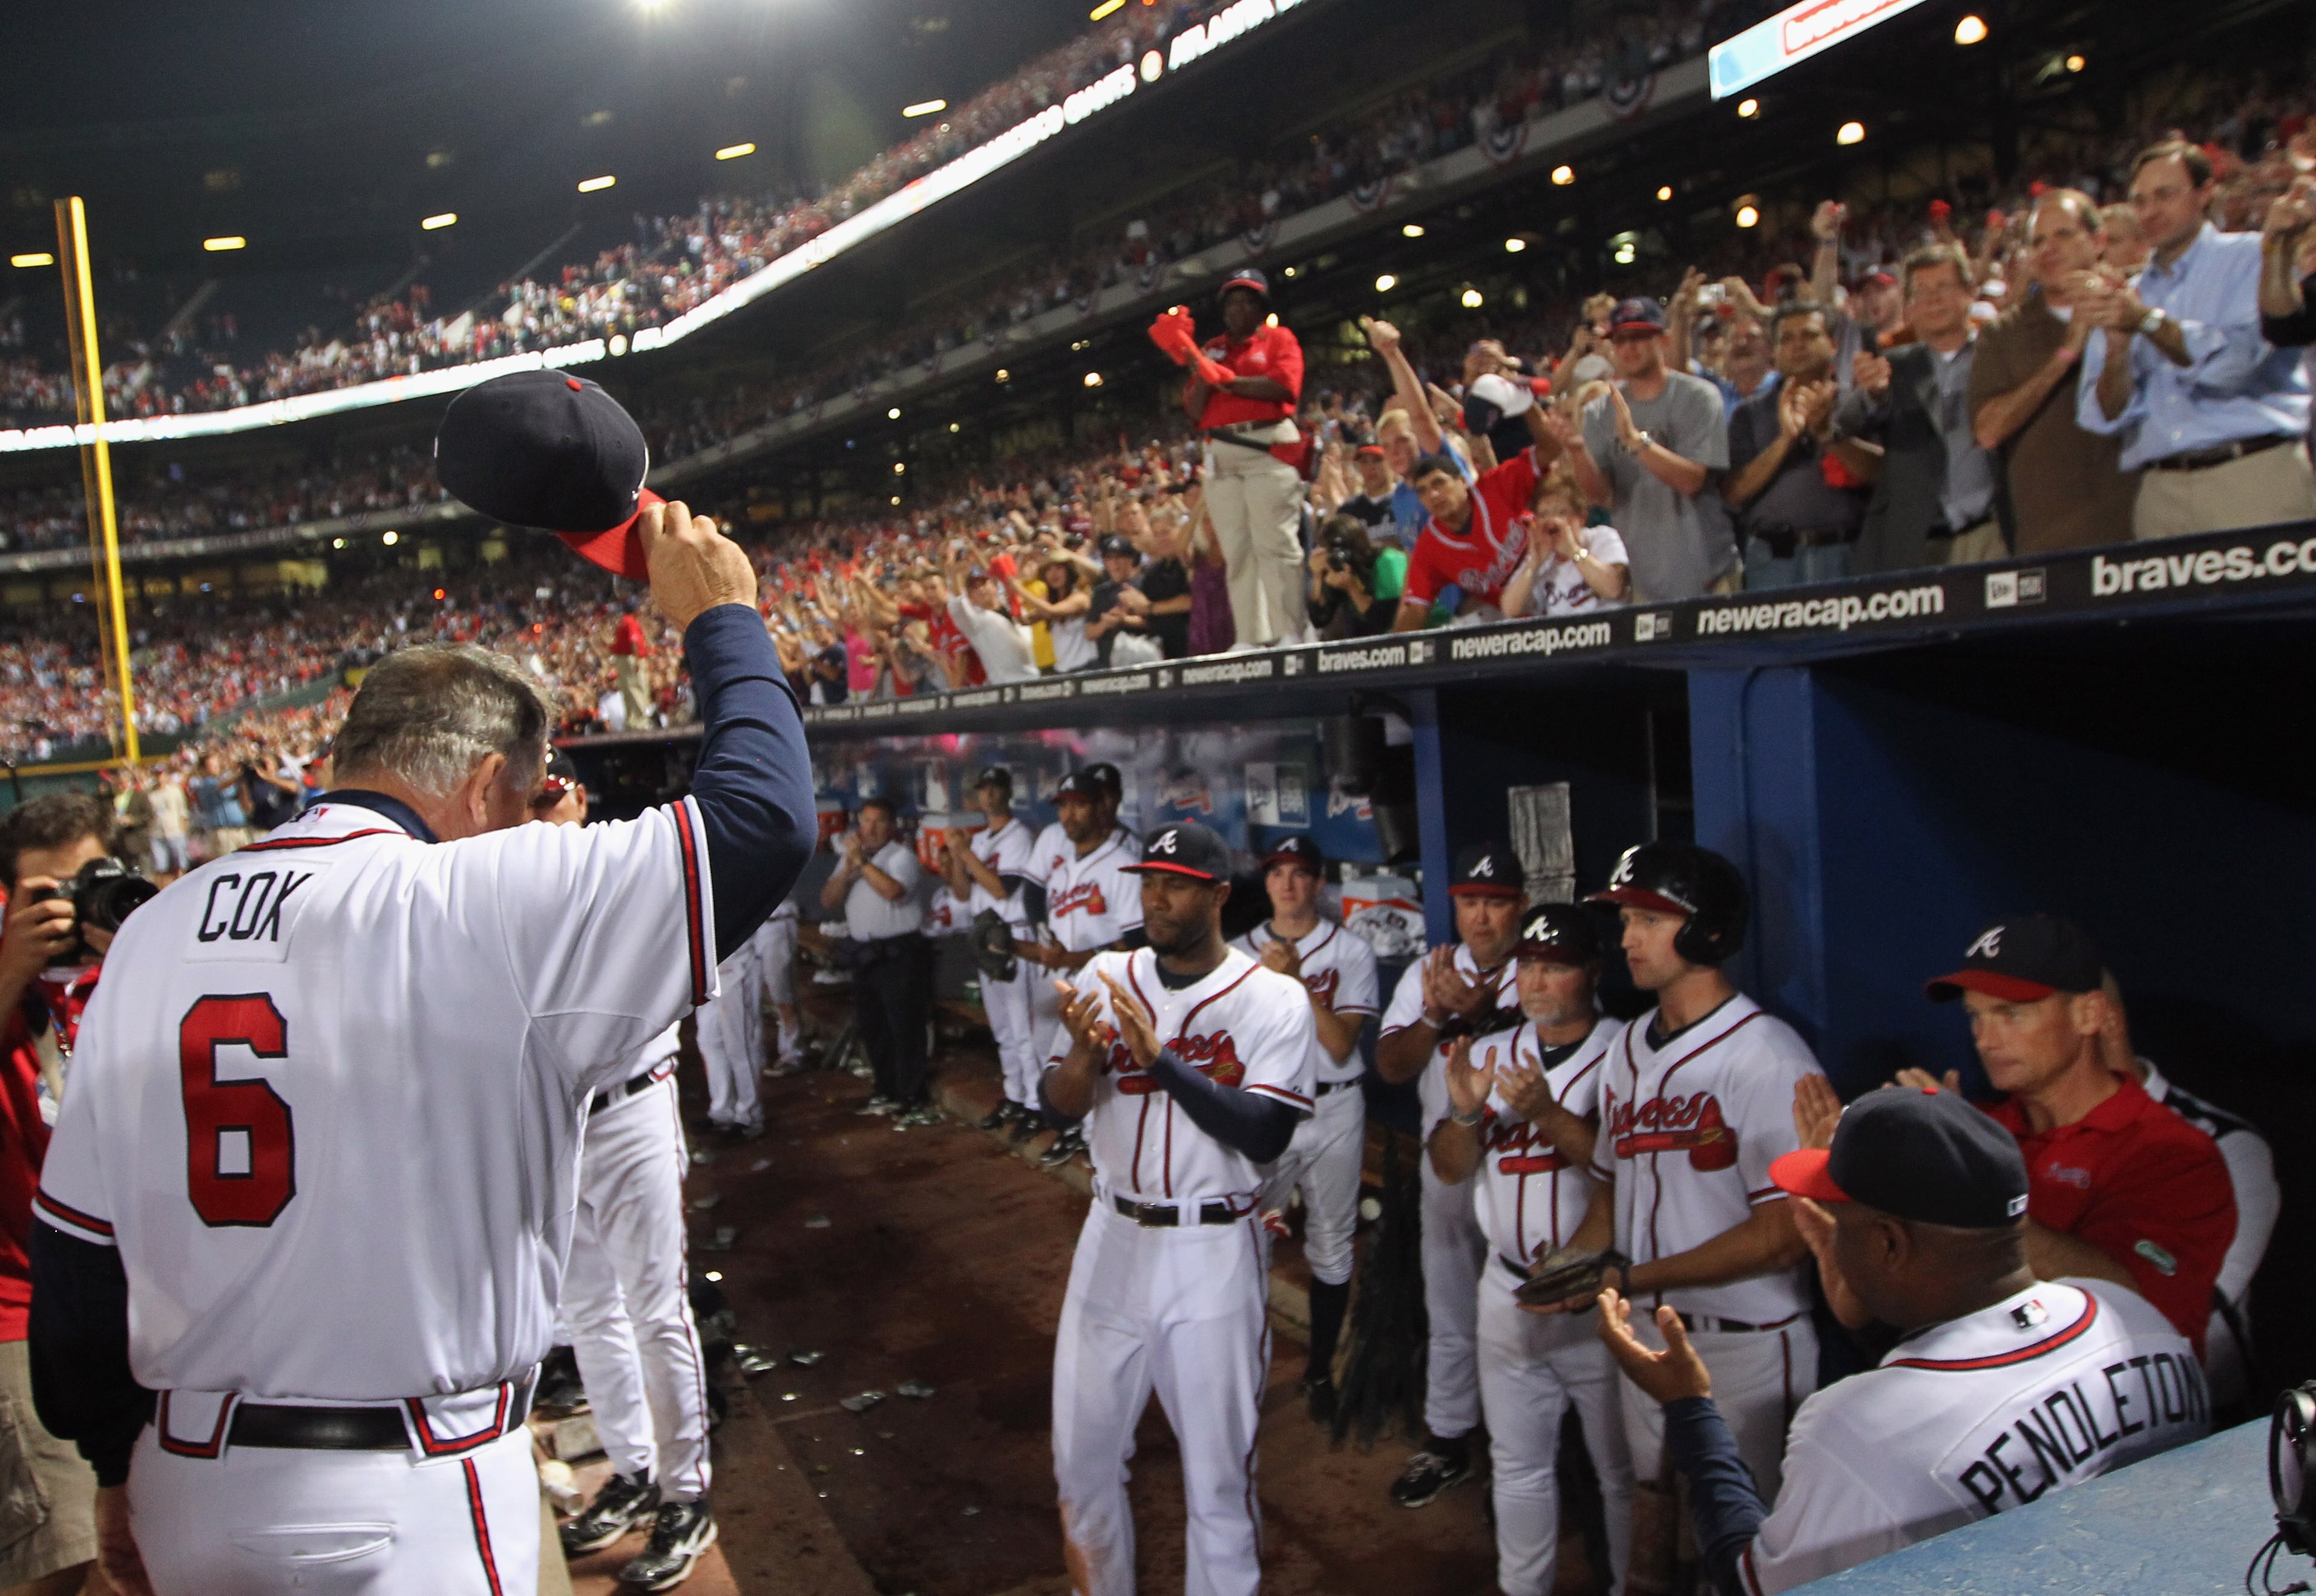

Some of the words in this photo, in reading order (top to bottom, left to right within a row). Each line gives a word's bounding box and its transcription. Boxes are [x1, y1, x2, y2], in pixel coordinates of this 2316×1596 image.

[1317, 644, 1405, 673] braves.com
[1452, 621, 1610, 659] neweracap.com
[1696, 583, 1944, 635] neweracap.com
[197, 870, 313, 943] COX
[179, 992, 297, 1228] 6
[1958, 1352, 2208, 1514] PENDLETON
